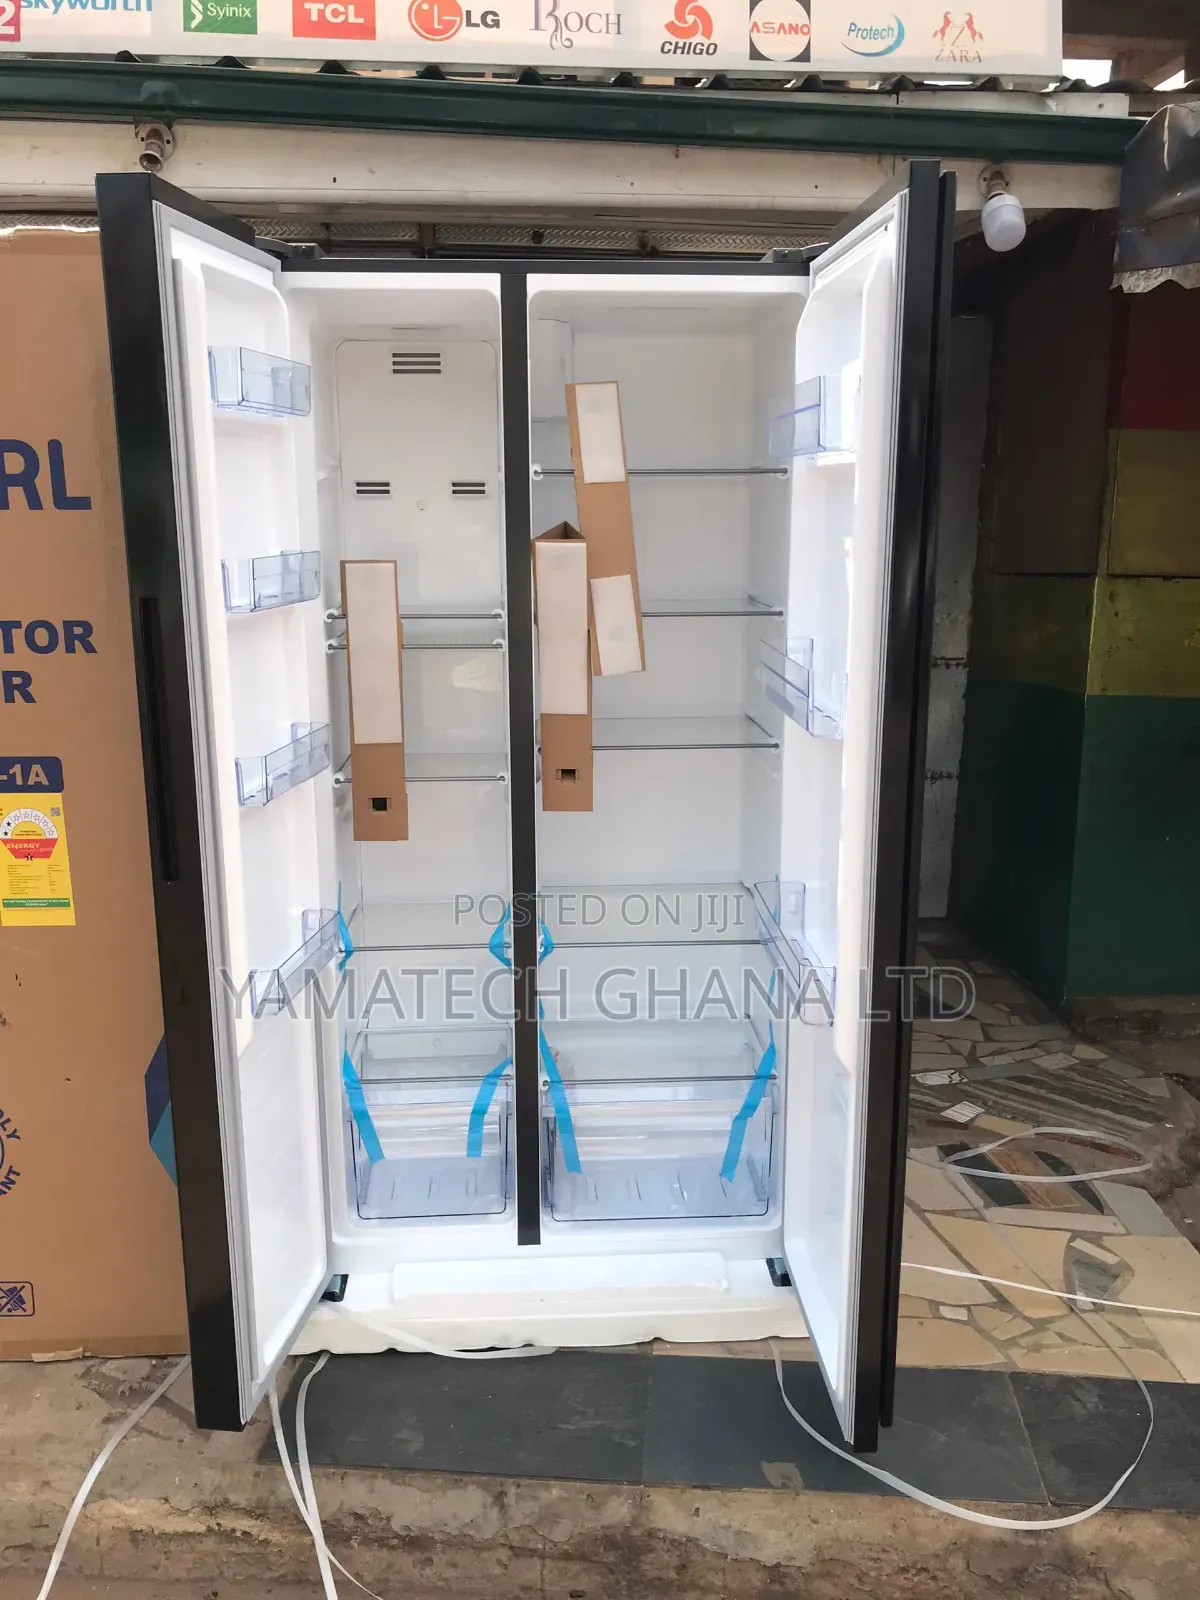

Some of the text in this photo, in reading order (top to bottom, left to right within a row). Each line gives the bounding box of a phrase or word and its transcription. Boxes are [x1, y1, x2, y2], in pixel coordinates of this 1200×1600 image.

[207, 3, 251, 20] Syinix
[304, 3, 364, 24] TCL
[465, 10, 500, 29] LG
[750, 21, 811, 36] ASANO
[847, 22, 895, 40] Protech
[660, 41, 718, 56] CHIGO
[935, 48, 982, 63] ZARA
[0, 438, 92, 511] RL
[0, 619, 98, 654] TOR
[1, 670, 37, 704] R
[6, 842, 40, 850] ENERGY
